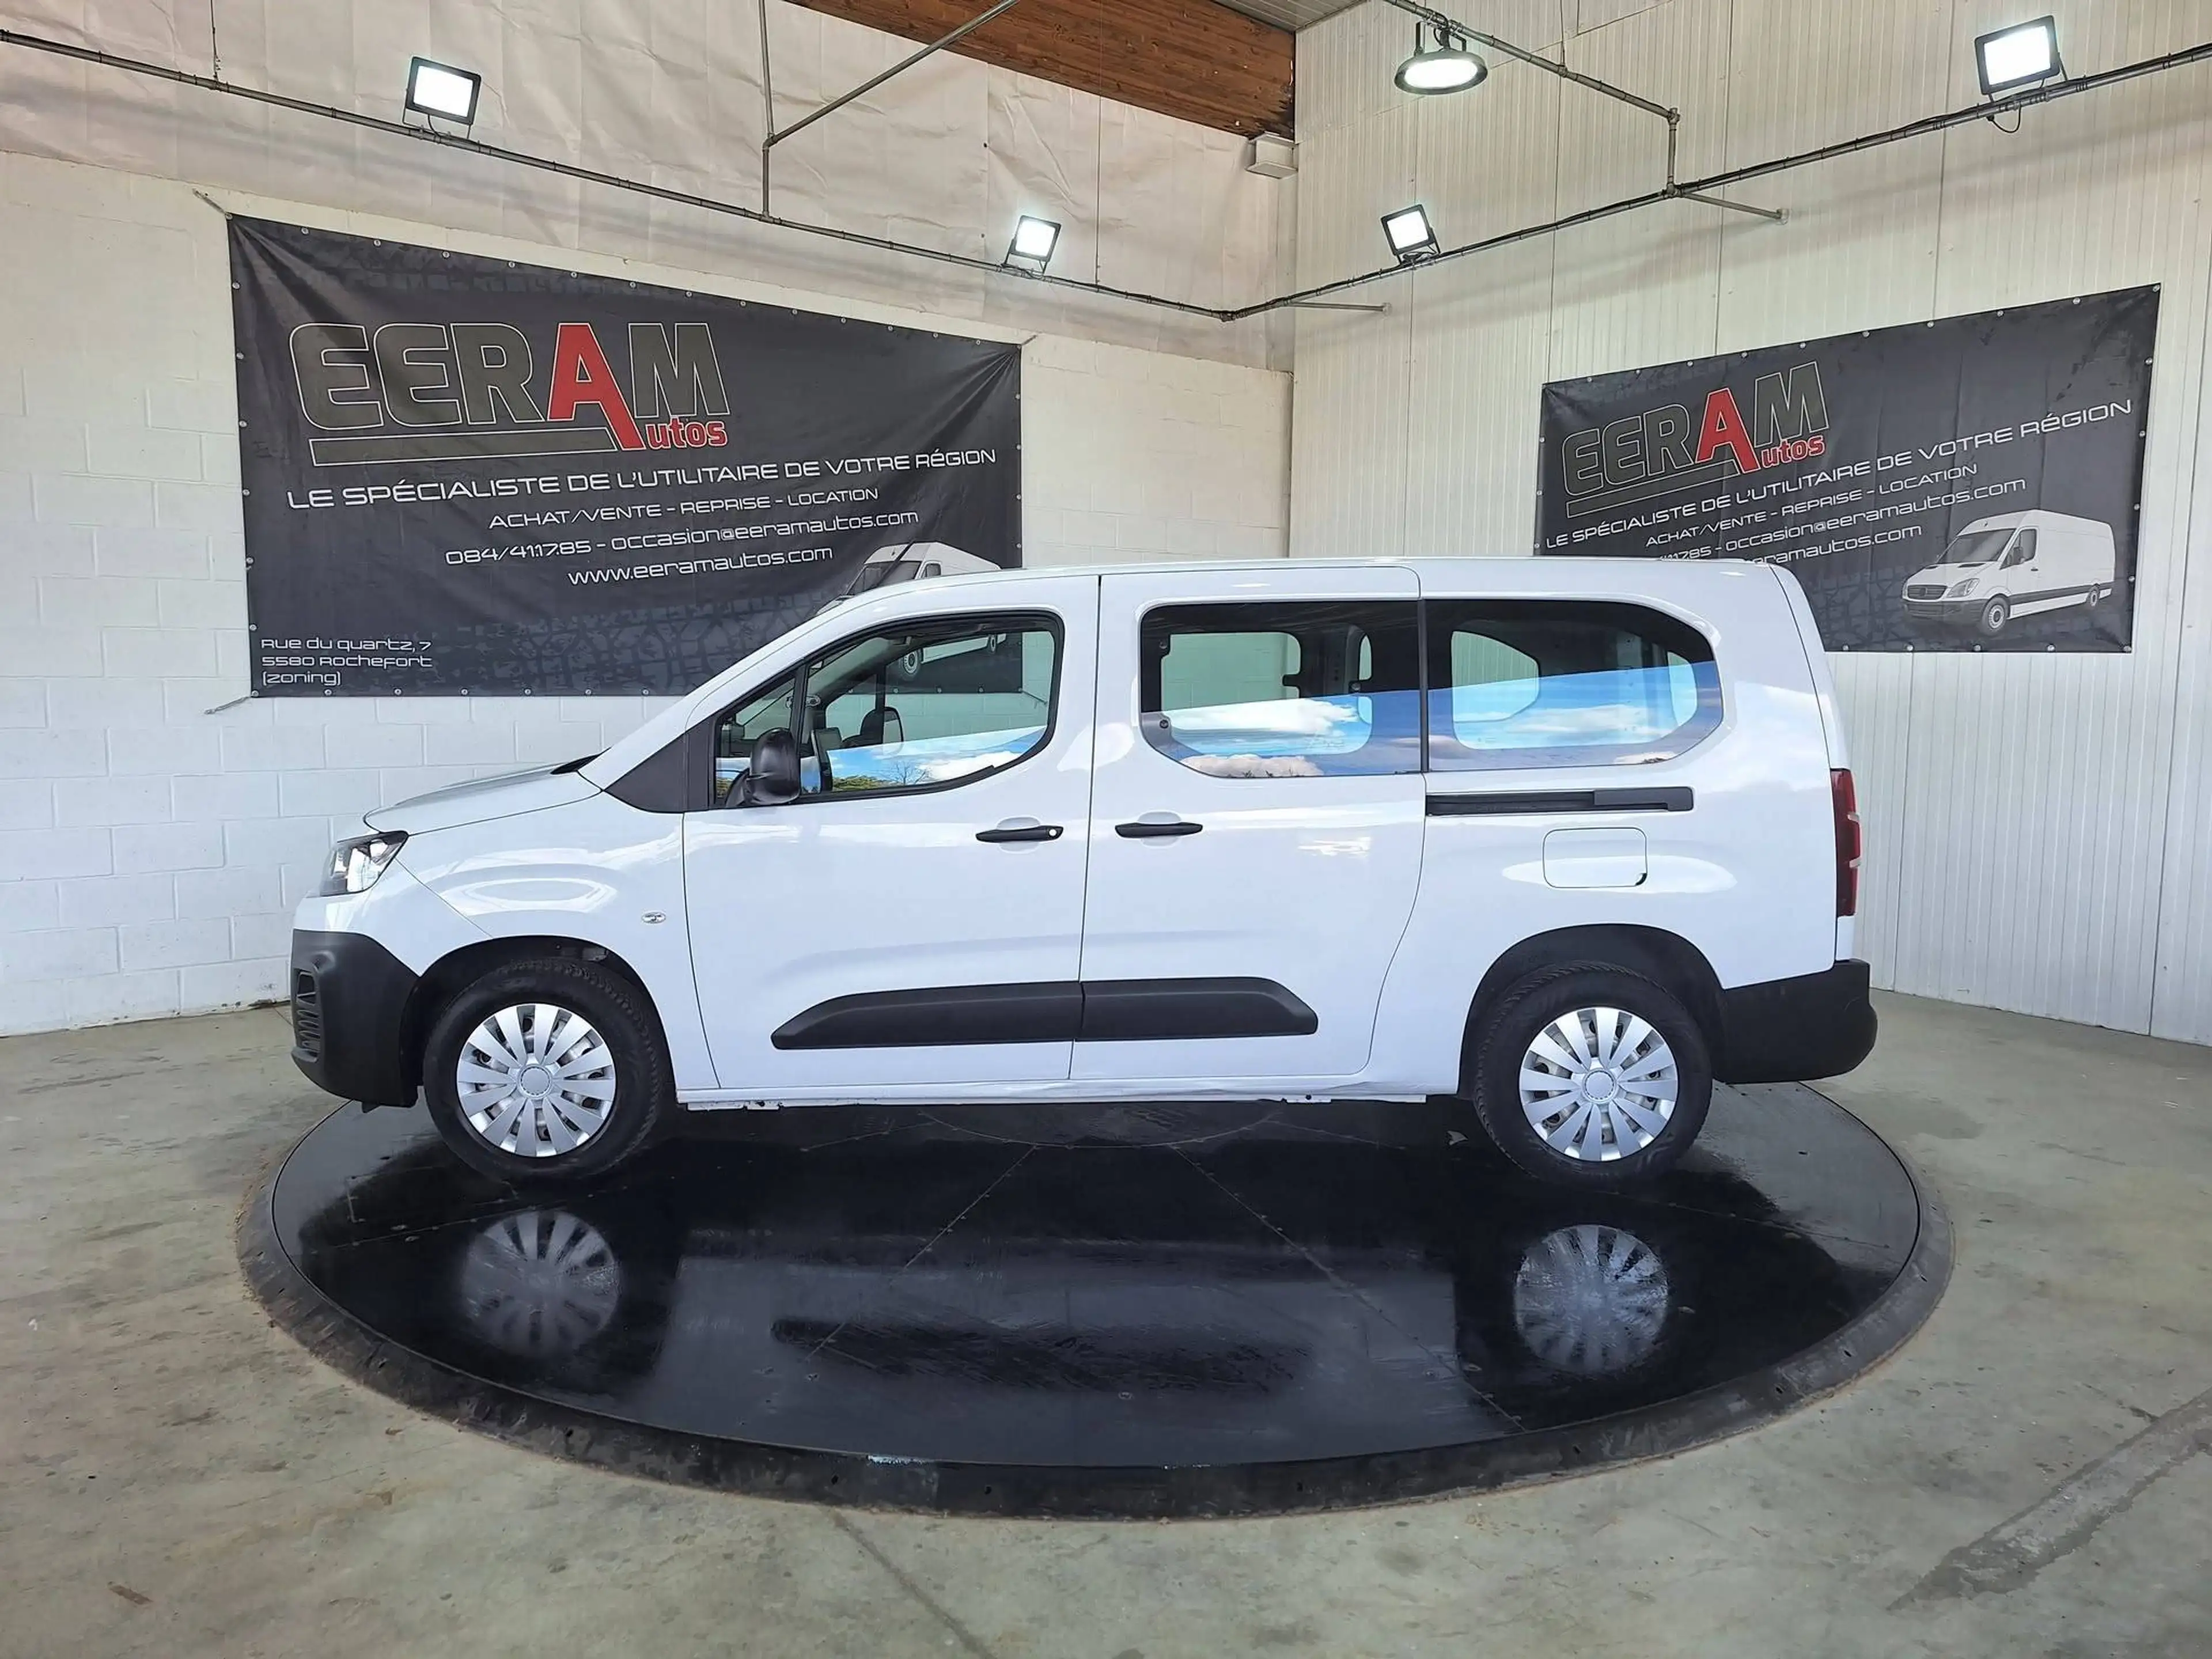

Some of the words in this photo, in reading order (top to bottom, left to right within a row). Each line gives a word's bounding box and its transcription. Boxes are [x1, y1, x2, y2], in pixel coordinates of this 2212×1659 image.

[290, 323, 730, 451] EERAM
[1562, 361, 1830, 497] EERAM
[287, 488, 334, 509] LE
[342, 478, 560, 506] SPÉCIALISTE
[566, 472, 611, 492] DE
[617, 464, 778, 488] L'UTILITAIRE
[785, 461, 821, 478] DE
[825, 455, 910, 475] VOTRE
[680, 496, 771, 514] REPRISE
[787, 487, 879, 506] LOCATION
[1546, 533, 1568, 549] LE
[1572, 502, 1696, 543] SPÉCIALISTE
[1701, 494, 1730, 513] DE
[1736, 460, 1872, 504] L'UTILITAIRE
[1877, 450, 1912, 471] DE
[1918, 427, 2013, 461] VOTRE
[1781, 488, 1862, 517] REPRISE
[1878, 463, 1977, 495] LOCATION
[445, 540, 592, 565] 084/41.17.85
[611, 510, 918, 551] occasion@eeramautos.com
[1726, 478, 2026, 552] occasion@eeramautos.com
[568, 547, 832, 585] www.eeramautos.com
[261, 639, 302, 650] Rue
[306, 637, 332, 649] du
[337, 638, 415, 653] quartz,
[419, 641, 431, 651] 7
[262, 656, 315, 666] 5580
[319, 654, 432, 669] Rochefort
[263, 671, 341, 686] (zoning)
